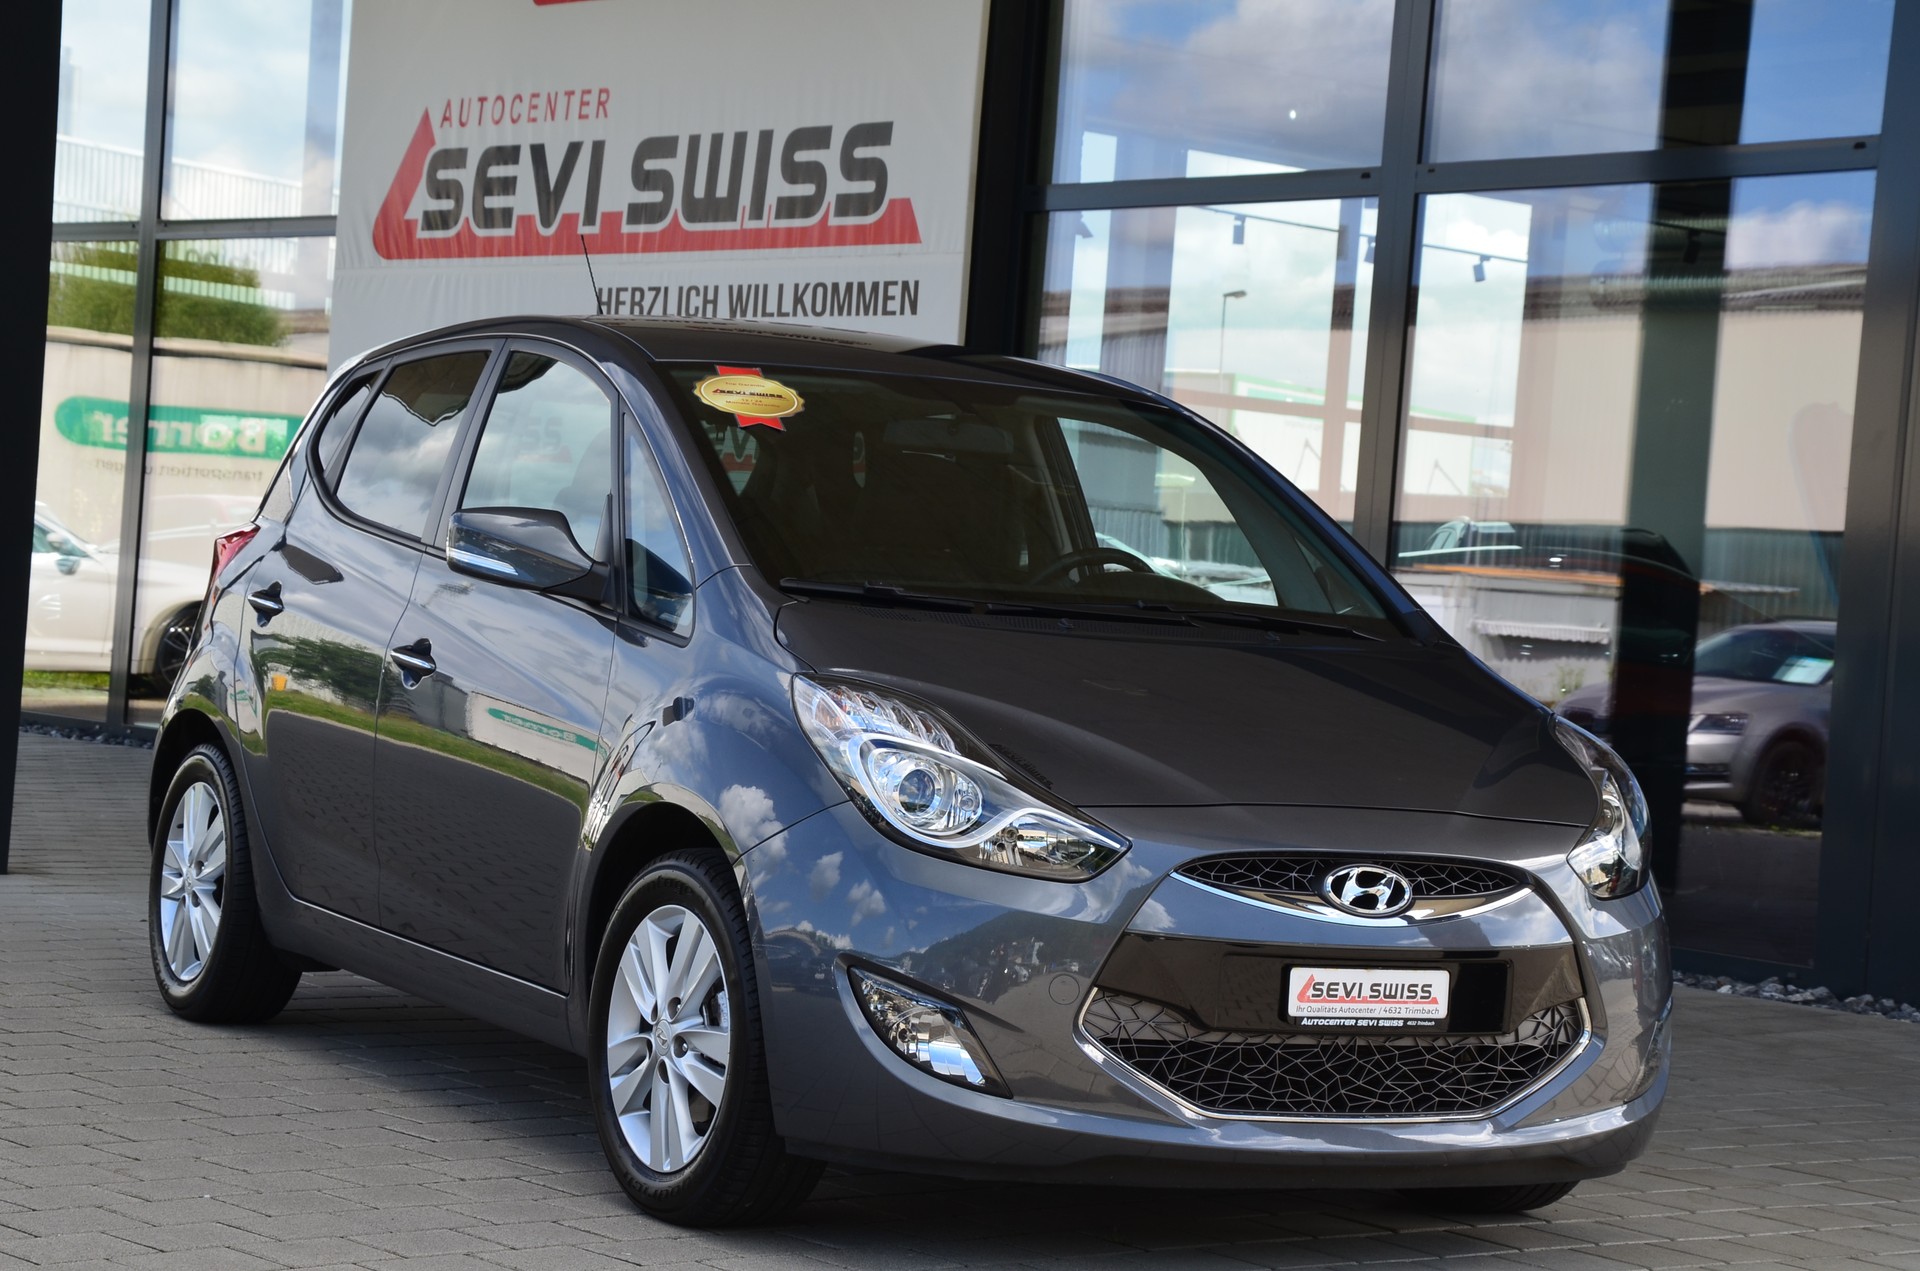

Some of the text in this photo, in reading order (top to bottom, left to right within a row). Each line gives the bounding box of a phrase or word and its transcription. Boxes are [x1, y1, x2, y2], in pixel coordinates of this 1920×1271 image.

[440, 87, 610, 128] AUTOCENTER
[420, 121, 895, 231] SEVI SWISS
[597, 280, 919, 318] HERZLICH WILLKOMMEN
[1311, 981, 1433, 1000] SEVI SWISS
[1296, 1005, 1306, 1013] Ihr
[1338, 1006, 1376, 1014] Autocenter
[1404, 1006, 1440, 1015] Trimbach
[1378, 1019, 1404, 1027] SWISS
